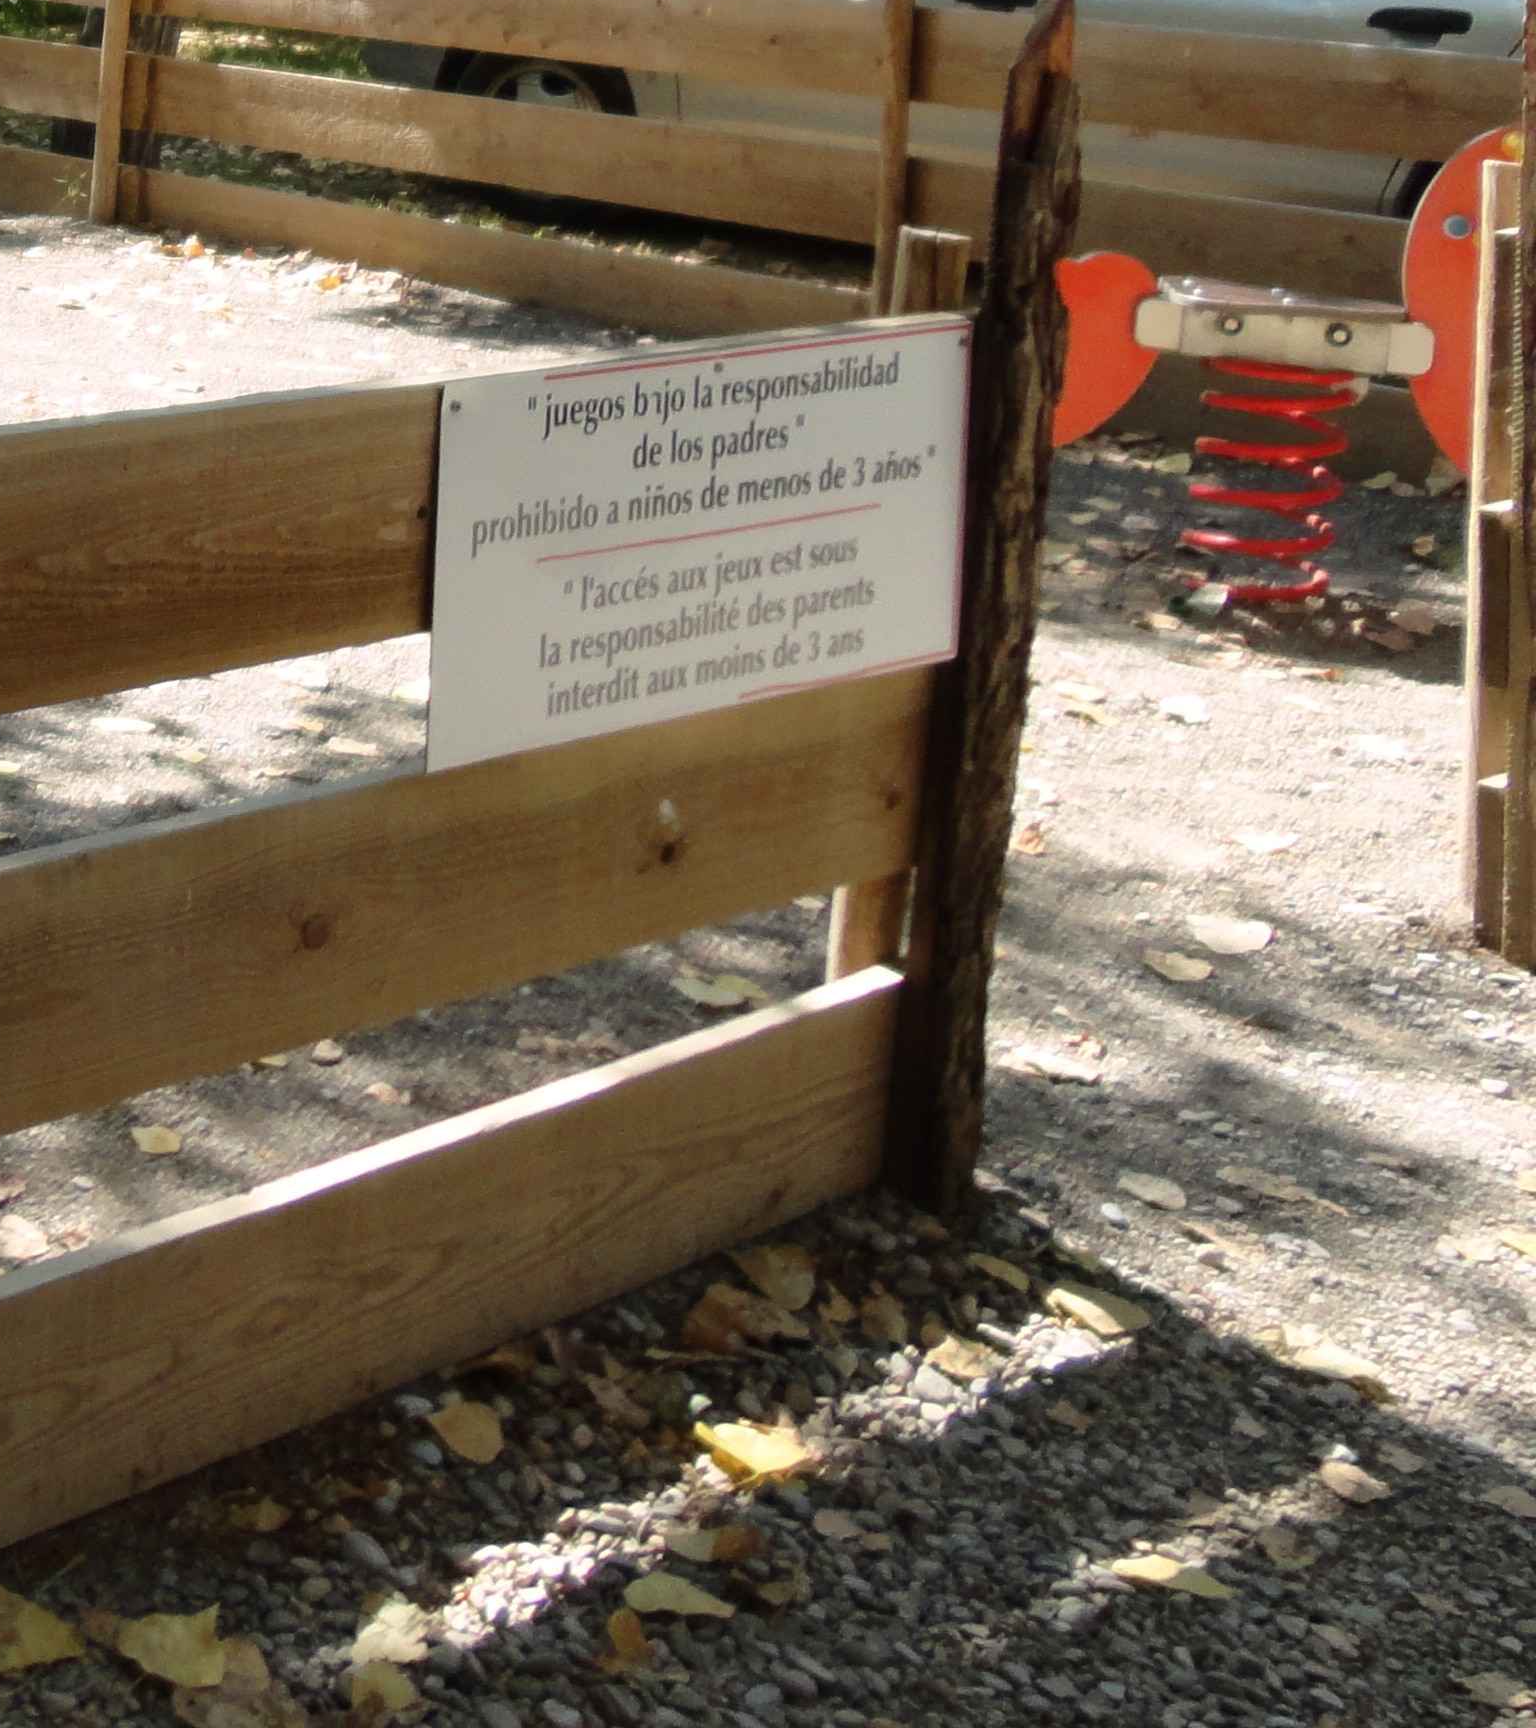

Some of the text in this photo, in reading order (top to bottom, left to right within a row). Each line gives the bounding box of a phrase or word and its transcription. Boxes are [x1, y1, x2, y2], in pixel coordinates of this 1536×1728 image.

[692, 375, 712, 410] la
[721, 351, 901, 413] responsabilidad
[633, 433, 663, 469] de
[670, 429, 703, 464] los
[471, 494, 599, 559] prohibido
[606, 500, 620, 525] a
[628, 483, 693, 522] niños
[701, 474, 730, 509] de
[737, 470, 812, 504] menos
[819, 457, 847, 493] de
[852, 456, 866, 487] 3
[666, 566, 708, 595] aux
[714, 551, 764, 598] jeux
[770, 541, 803, 575] est
[808, 537, 859, 569] sous
[540, 576, 876, 668] la responsabilité des parents
[547, 628, 866, 717] interdit aux moins de 3 ans
